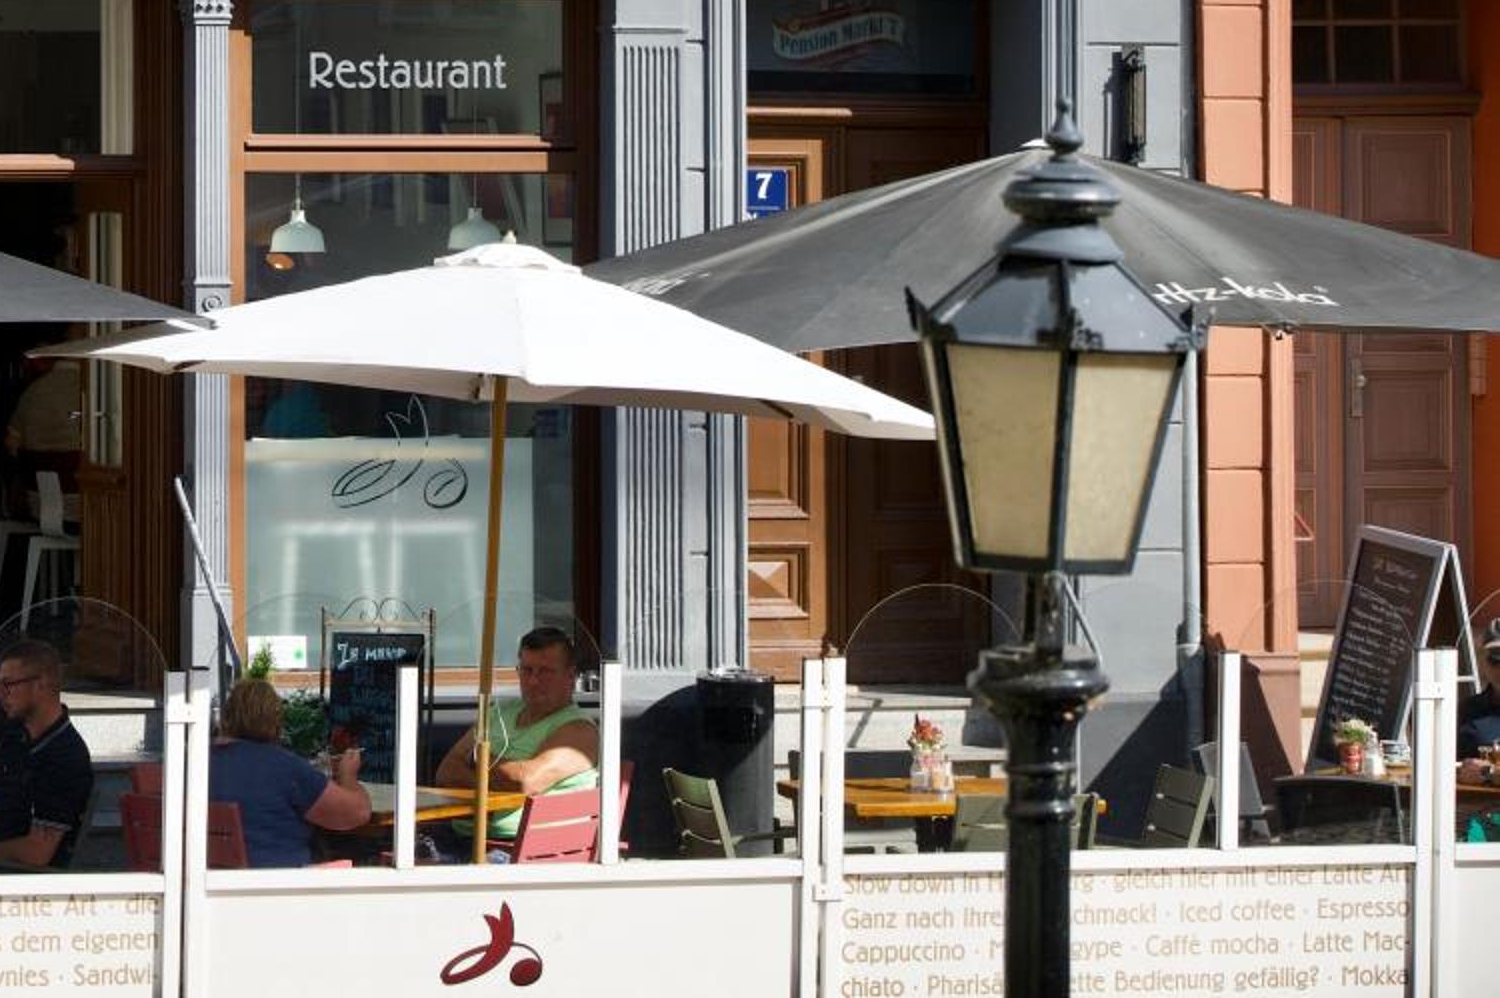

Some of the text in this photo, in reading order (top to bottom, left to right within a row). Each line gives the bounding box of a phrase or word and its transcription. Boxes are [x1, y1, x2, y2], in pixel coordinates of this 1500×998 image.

[309, 51, 507, 89] Restaurant
[755, 172, 773, 199] 7
[844, 873, 890, 896] Slow
[898, 871, 956, 894] down
[963, 871, 981, 893] in
[1113, 867, 1173, 892] gleich
[1180, 866, 1218, 889] hier
[1225, 865, 1258, 888] mit
[1266, 865, 1315, 887] einer
[1322, 863, 1374, 886] Latte
[63, 893, 97, 916] Art
[125, 891, 161, 915] die
[841, 898, 1412, 930] Ganz nach Ihre chmack! Iced coffee Espresso
[11, 931, 60, 953] dem
[71, 930, 160, 954] eigenen
[841, 940, 966, 966] Cappuccino
[1211, 932, 1280, 955] mocha
[1302, 931, 1353, 953] Latte
[841, 974, 906, 998] chiato
[927, 974, 1005, 997] Pharisä
[1113, 968, 1225, 993] Bedienung
[1234, 964, 1321, 992] gefällig?
[1341, 963, 1411, 988] Mokka
